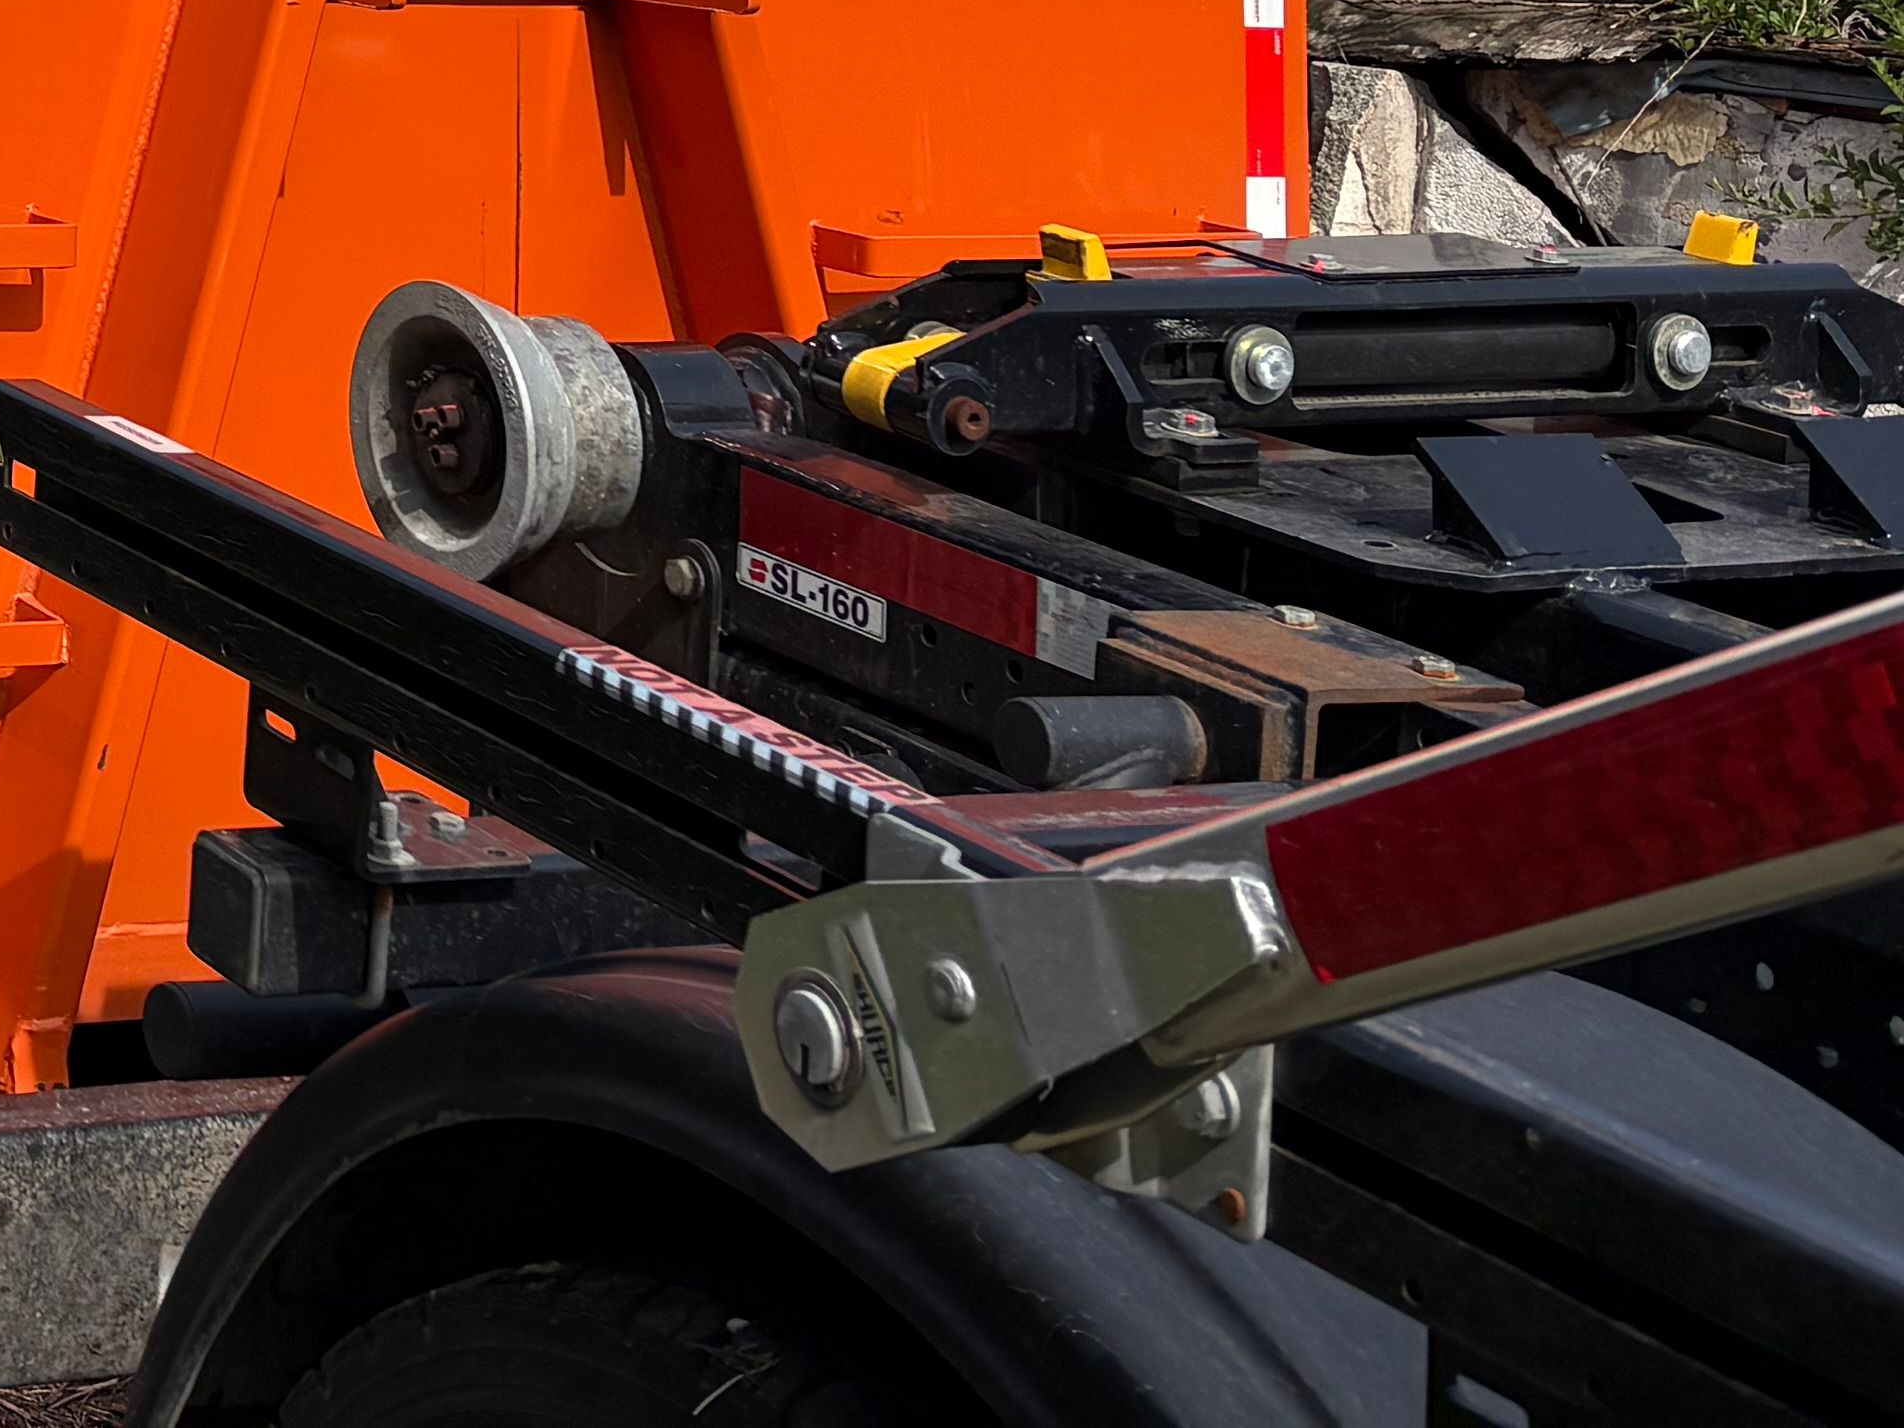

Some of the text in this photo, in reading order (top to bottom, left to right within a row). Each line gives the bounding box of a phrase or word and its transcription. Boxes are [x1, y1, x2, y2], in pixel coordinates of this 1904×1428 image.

[770, 563, 869, 628] SL-160
[588, 646, 932, 806] NOT A STEP
